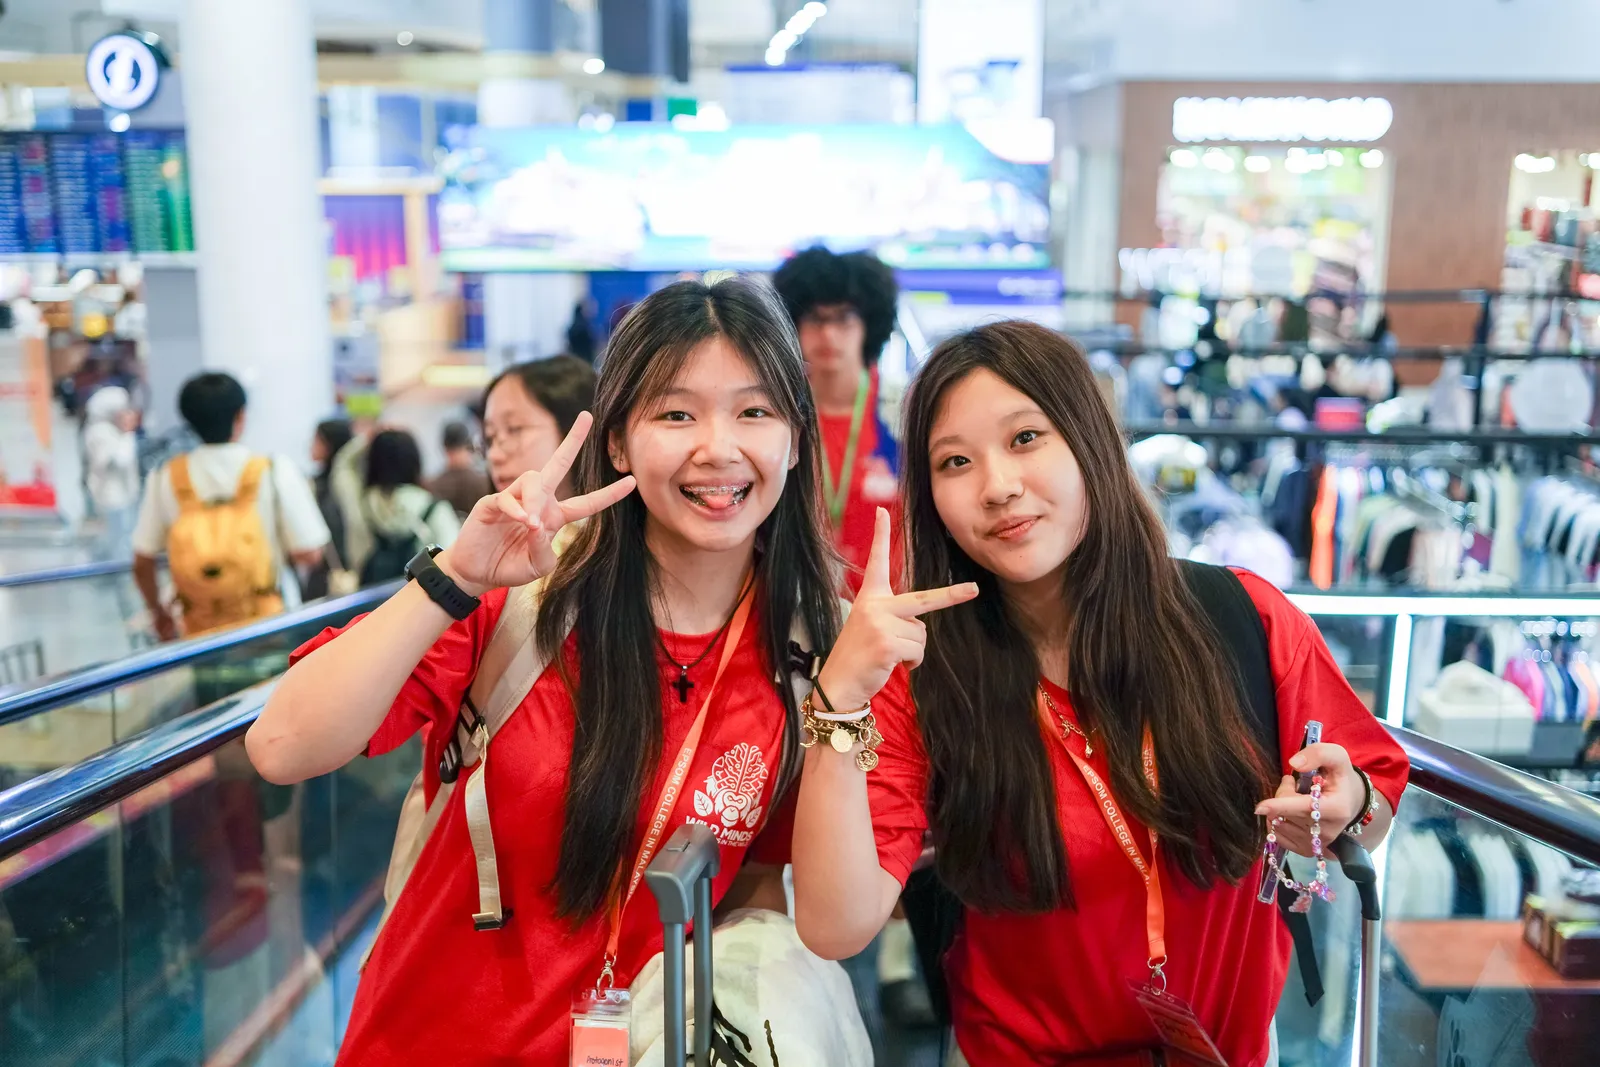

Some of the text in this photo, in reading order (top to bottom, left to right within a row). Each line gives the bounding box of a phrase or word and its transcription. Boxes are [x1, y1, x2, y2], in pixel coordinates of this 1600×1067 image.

[627, 747, 692, 900] EPSOM COLLEGE IN MALAYSIA
[720, 827, 754, 841] MINDS
[1083, 764, 1108, 800] EPSOM
[1103, 799, 1132, 846] COLLEGE
[1126, 846, 1137, 856] IN
